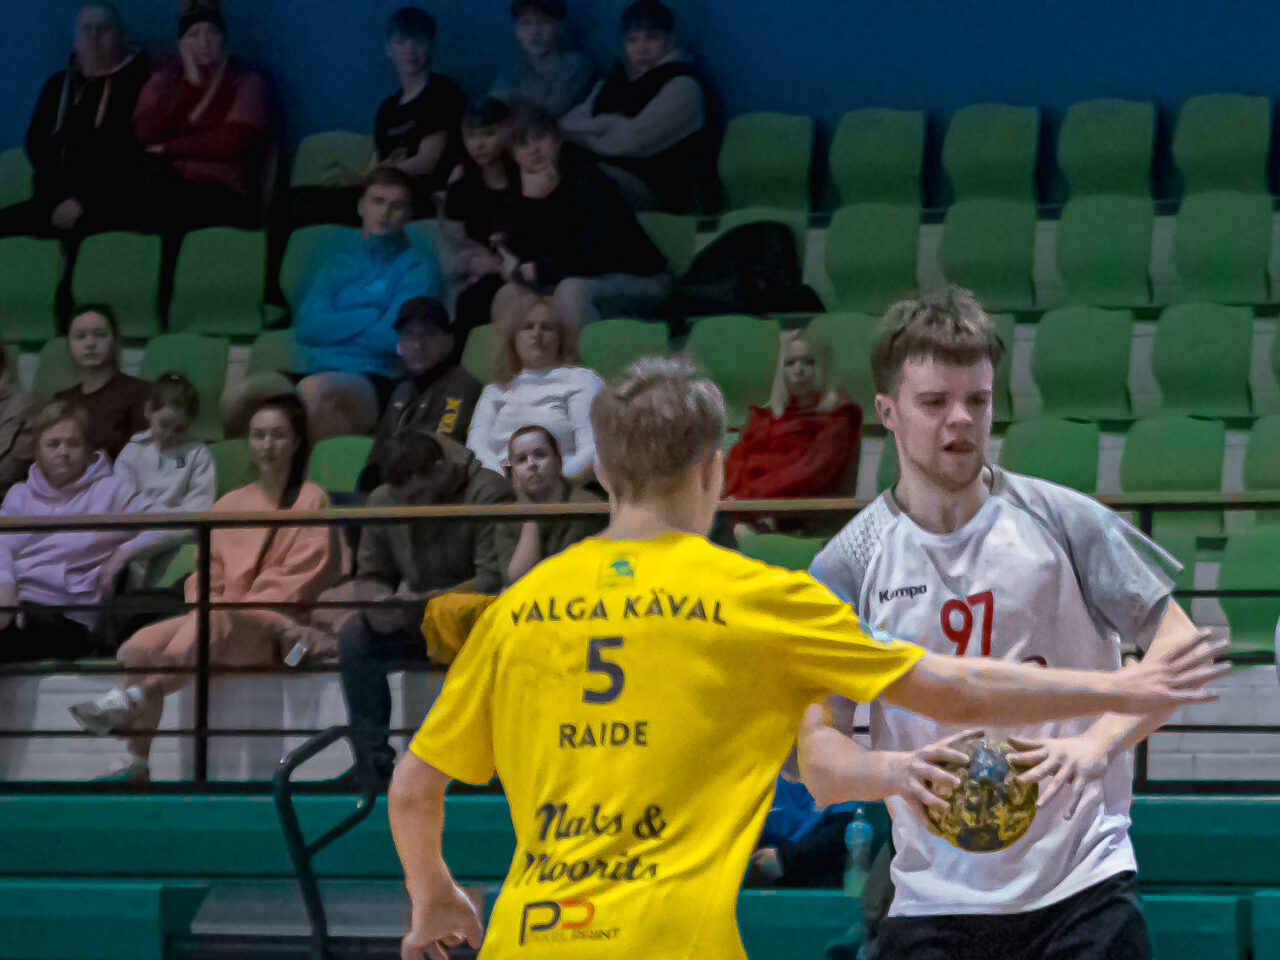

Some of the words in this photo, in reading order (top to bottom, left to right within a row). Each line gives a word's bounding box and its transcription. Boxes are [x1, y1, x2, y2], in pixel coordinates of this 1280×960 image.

[511, 596, 608, 626] VALGA
[623, 587, 726, 626] KÄVAL
[940, 590, 994, 656] 97
[582, 636, 625, 704] 5
[559, 721, 648, 748] RAIDE
[632, 804, 666, 838] &
